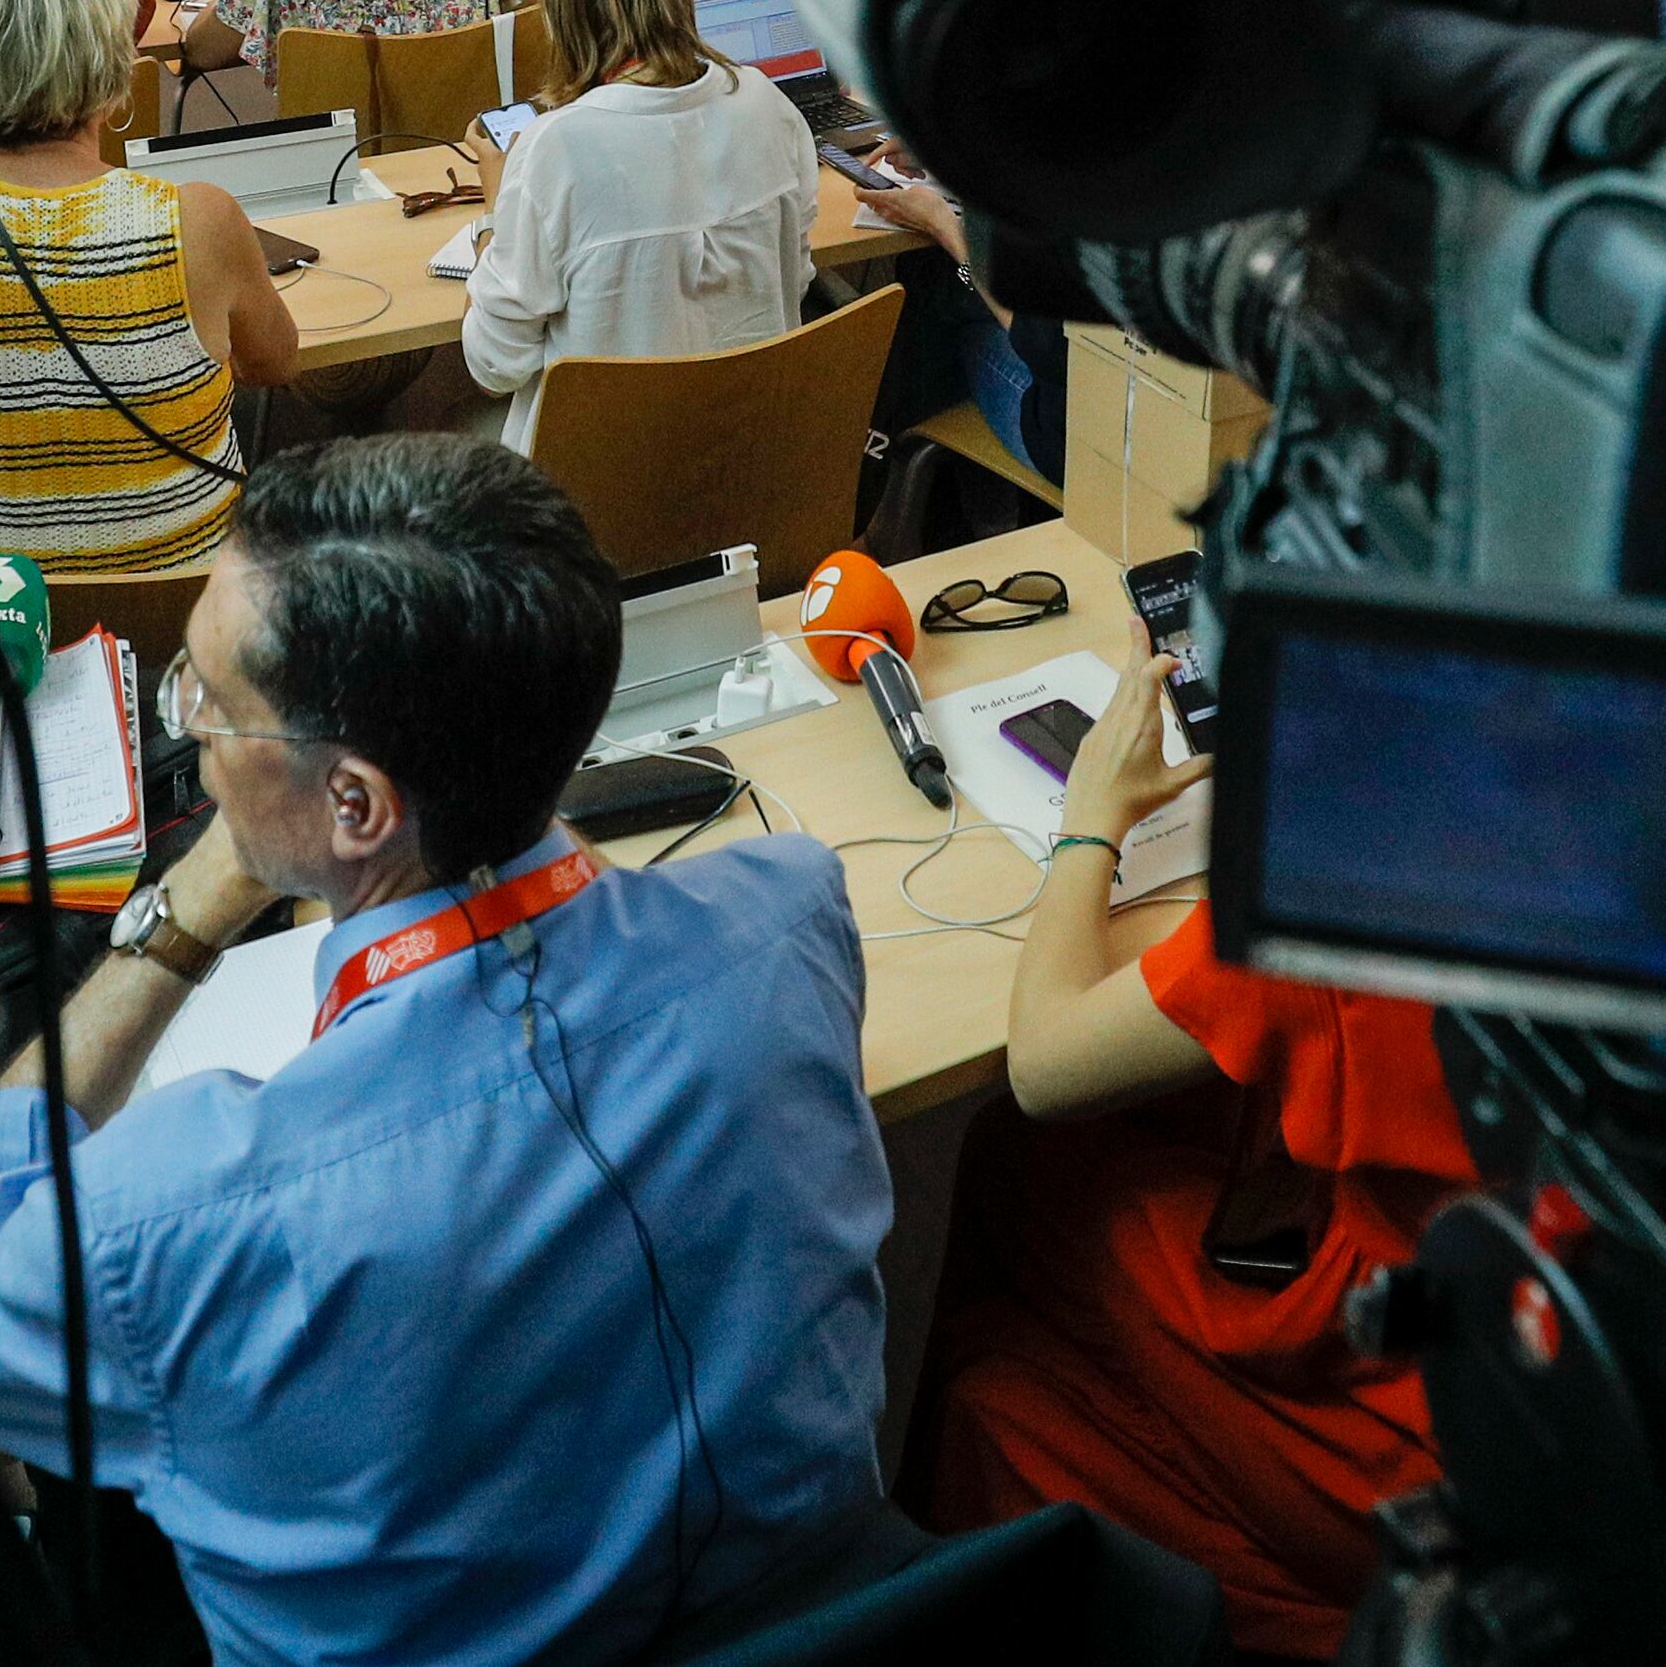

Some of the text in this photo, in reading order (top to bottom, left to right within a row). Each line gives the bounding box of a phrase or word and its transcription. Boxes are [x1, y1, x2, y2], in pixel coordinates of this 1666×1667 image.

[970, 683, 1048, 715] Ple del Consell
